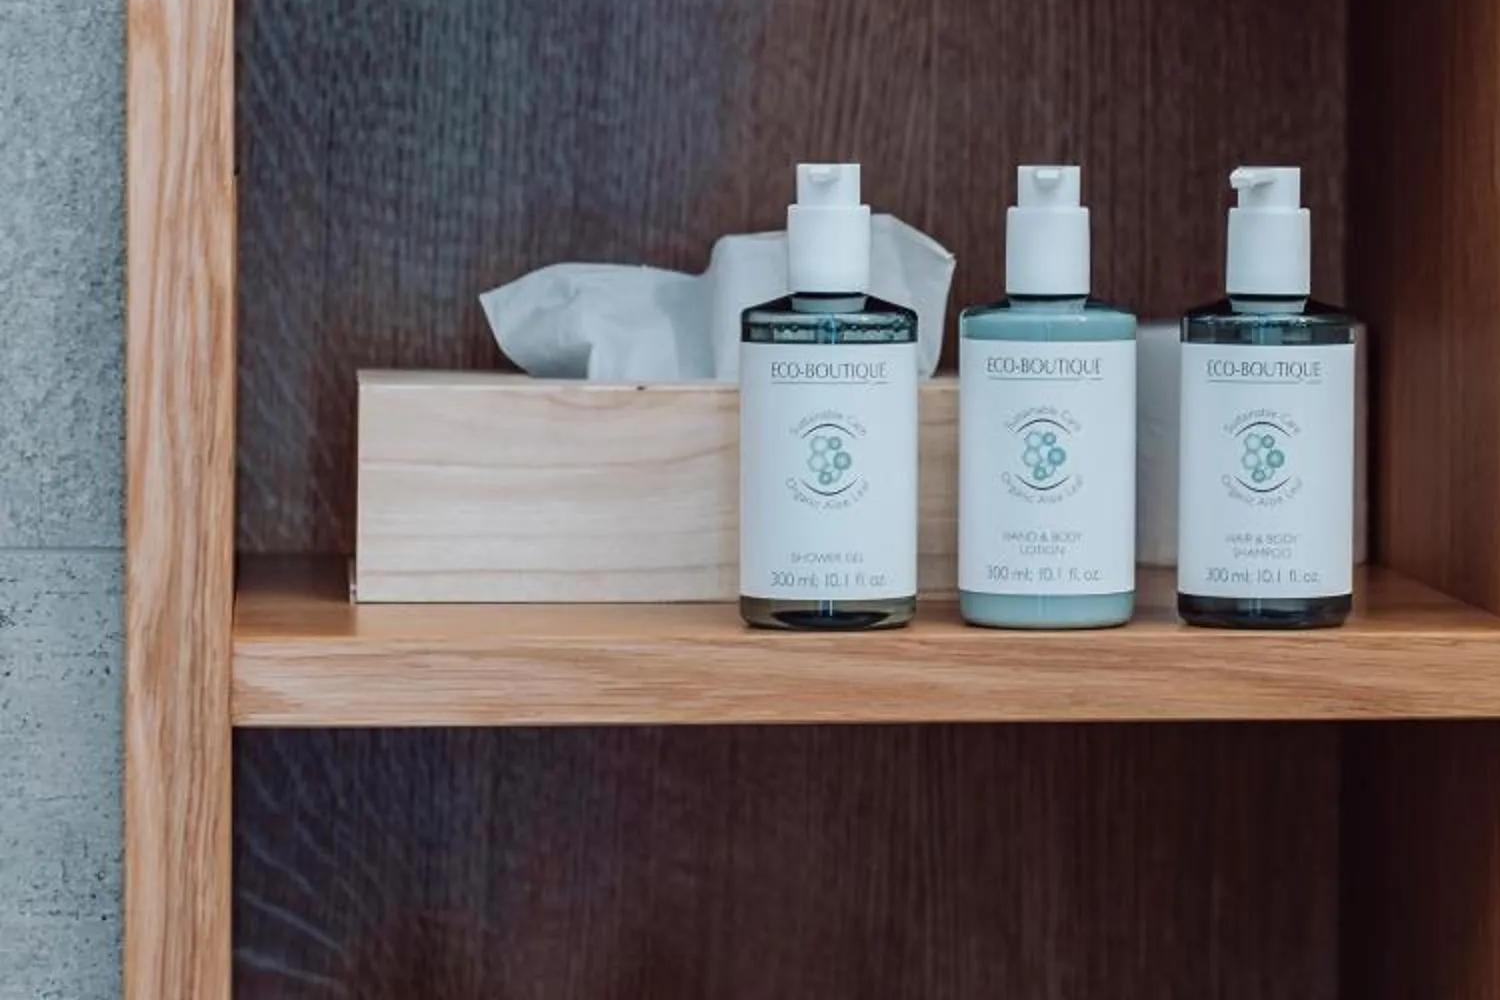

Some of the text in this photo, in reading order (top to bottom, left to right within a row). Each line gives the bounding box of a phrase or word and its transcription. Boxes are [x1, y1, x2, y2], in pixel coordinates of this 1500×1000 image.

[770, 361, 888, 380] ECO-BOUTIQUE
[986, 356, 1103, 376] ECO-BOUTIQUE
[1206, 359, 1323, 379] ECO-BOUTIQUE
[1040, 531, 1049, 542] &
[1051, 531, 1084, 542] BODY
[1255, 534, 1263, 544] &
[1266, 533, 1299, 544] BODY
[790, 551, 864, 563] SHOWER GEL
[1019, 544, 1067, 555] LOTION
[1231, 547, 1293, 559] SHAMPOO
[771, 570, 794, 587] 300
[825, 573, 849, 588] 10.1
[986, 565, 1009, 581] 300
[1039, 567, 1062, 581] 10.1
[1206, 567, 1229, 583] 300
[1257, 569, 1281, 583] 10.1
